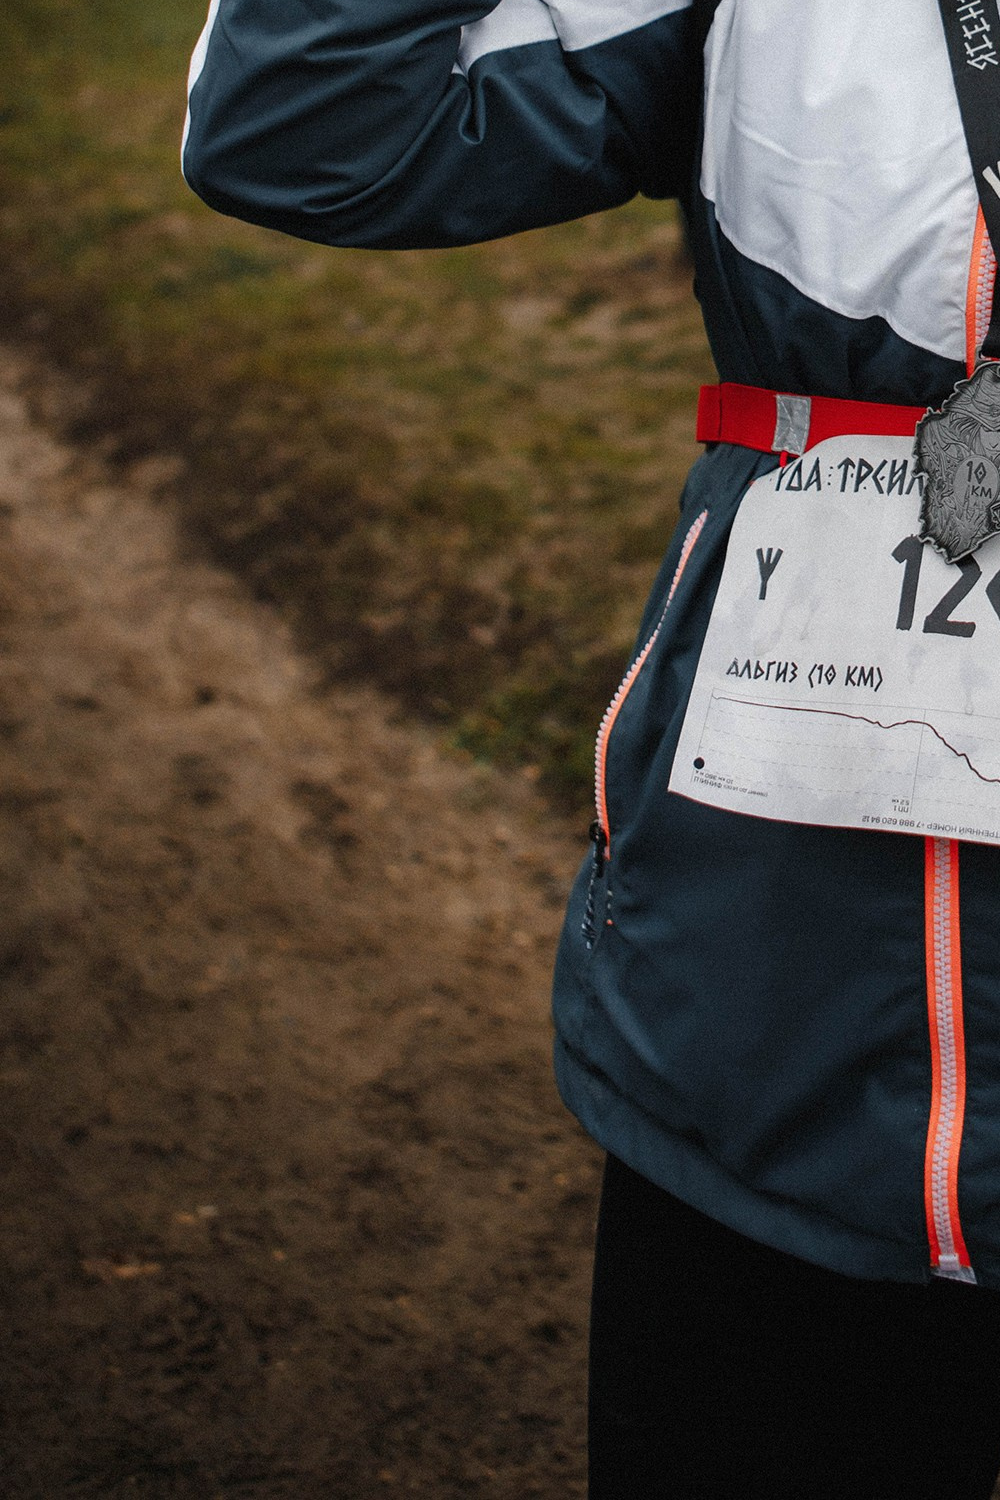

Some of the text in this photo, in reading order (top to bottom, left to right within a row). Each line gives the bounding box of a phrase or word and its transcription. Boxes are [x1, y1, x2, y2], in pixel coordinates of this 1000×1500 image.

[966, 461, 987, 485] 10
[726, 657, 799, 683] АЛЬГИЗ
[808, 663, 837, 689] (10
[693, 776, 722, 788] ФИНИШ
[861, 815, 870, 823] 12
[882, 817, 898, 826] 620
[927, 823, 957, 833] НОМЕР
